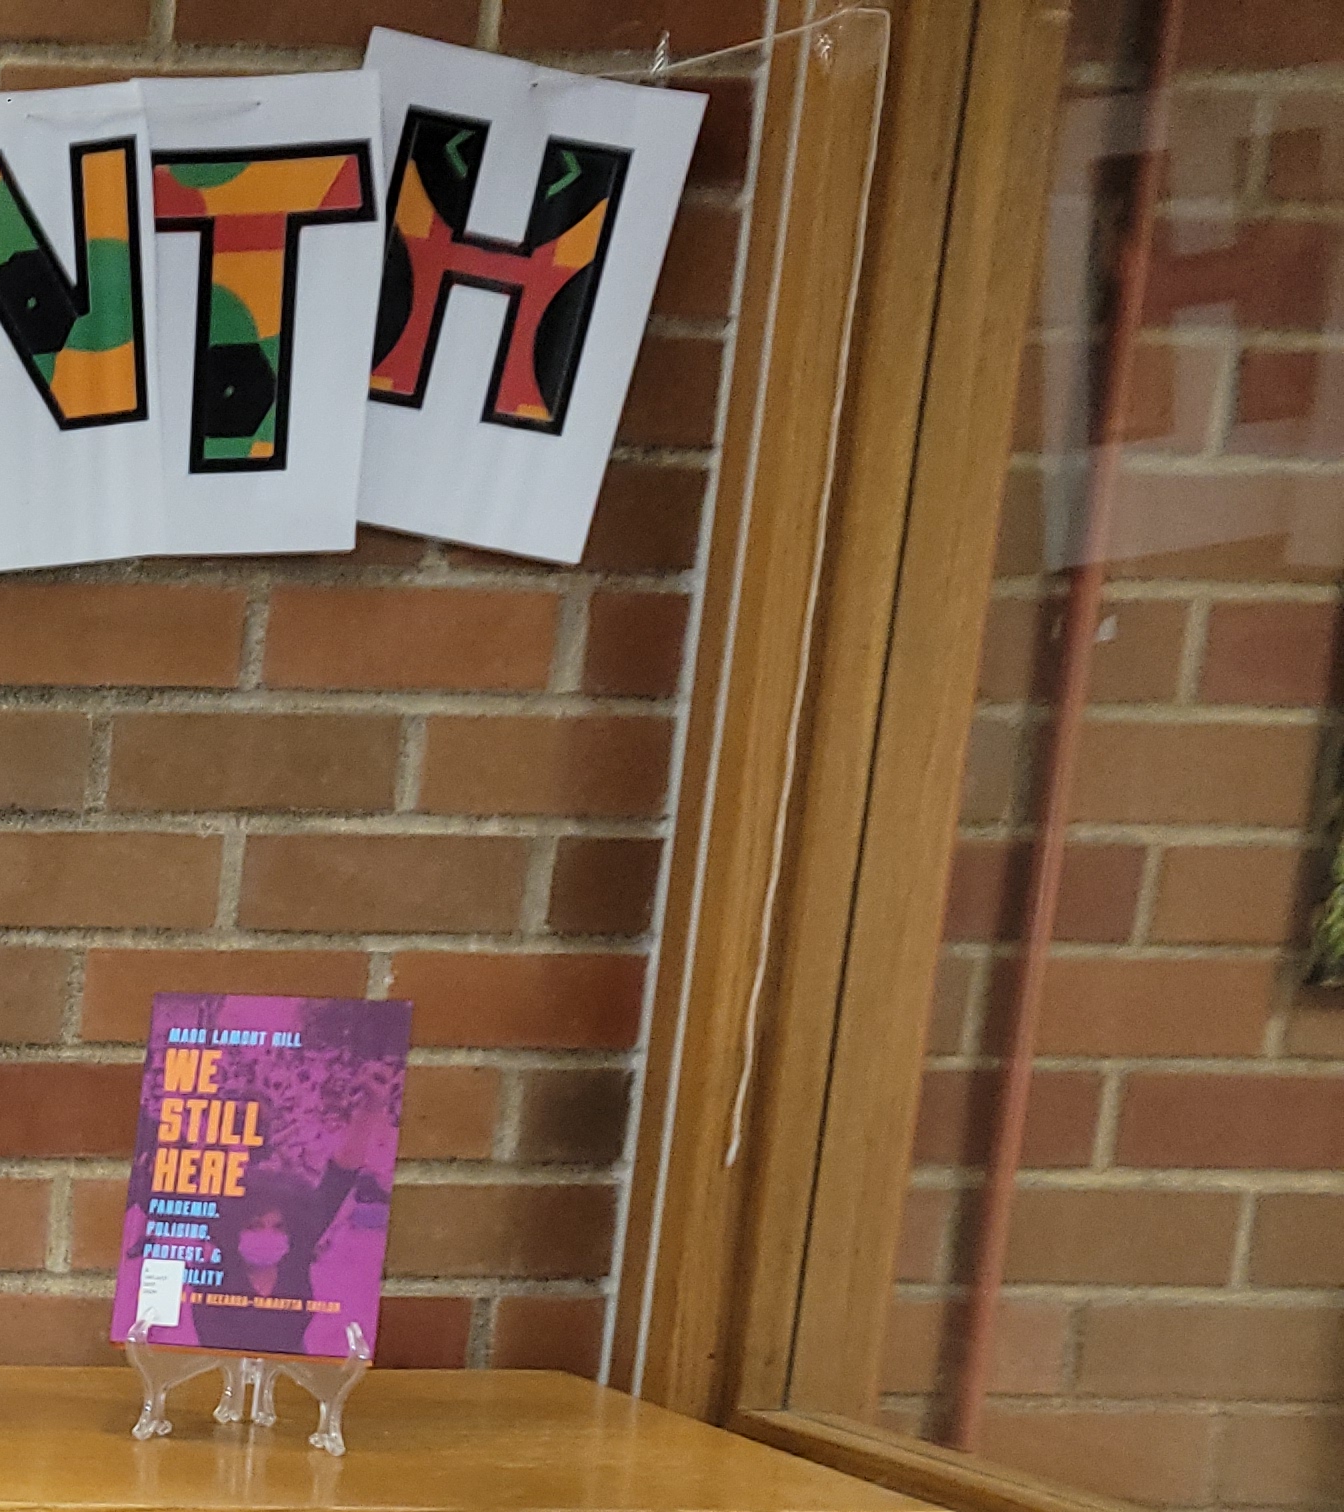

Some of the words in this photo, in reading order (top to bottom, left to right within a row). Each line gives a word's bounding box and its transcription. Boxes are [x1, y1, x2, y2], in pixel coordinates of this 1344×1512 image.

[163, 1049, 222, 1093] WE
[158, 1098, 263, 1146] STILL
[151, 1148, 249, 1196] HERE
